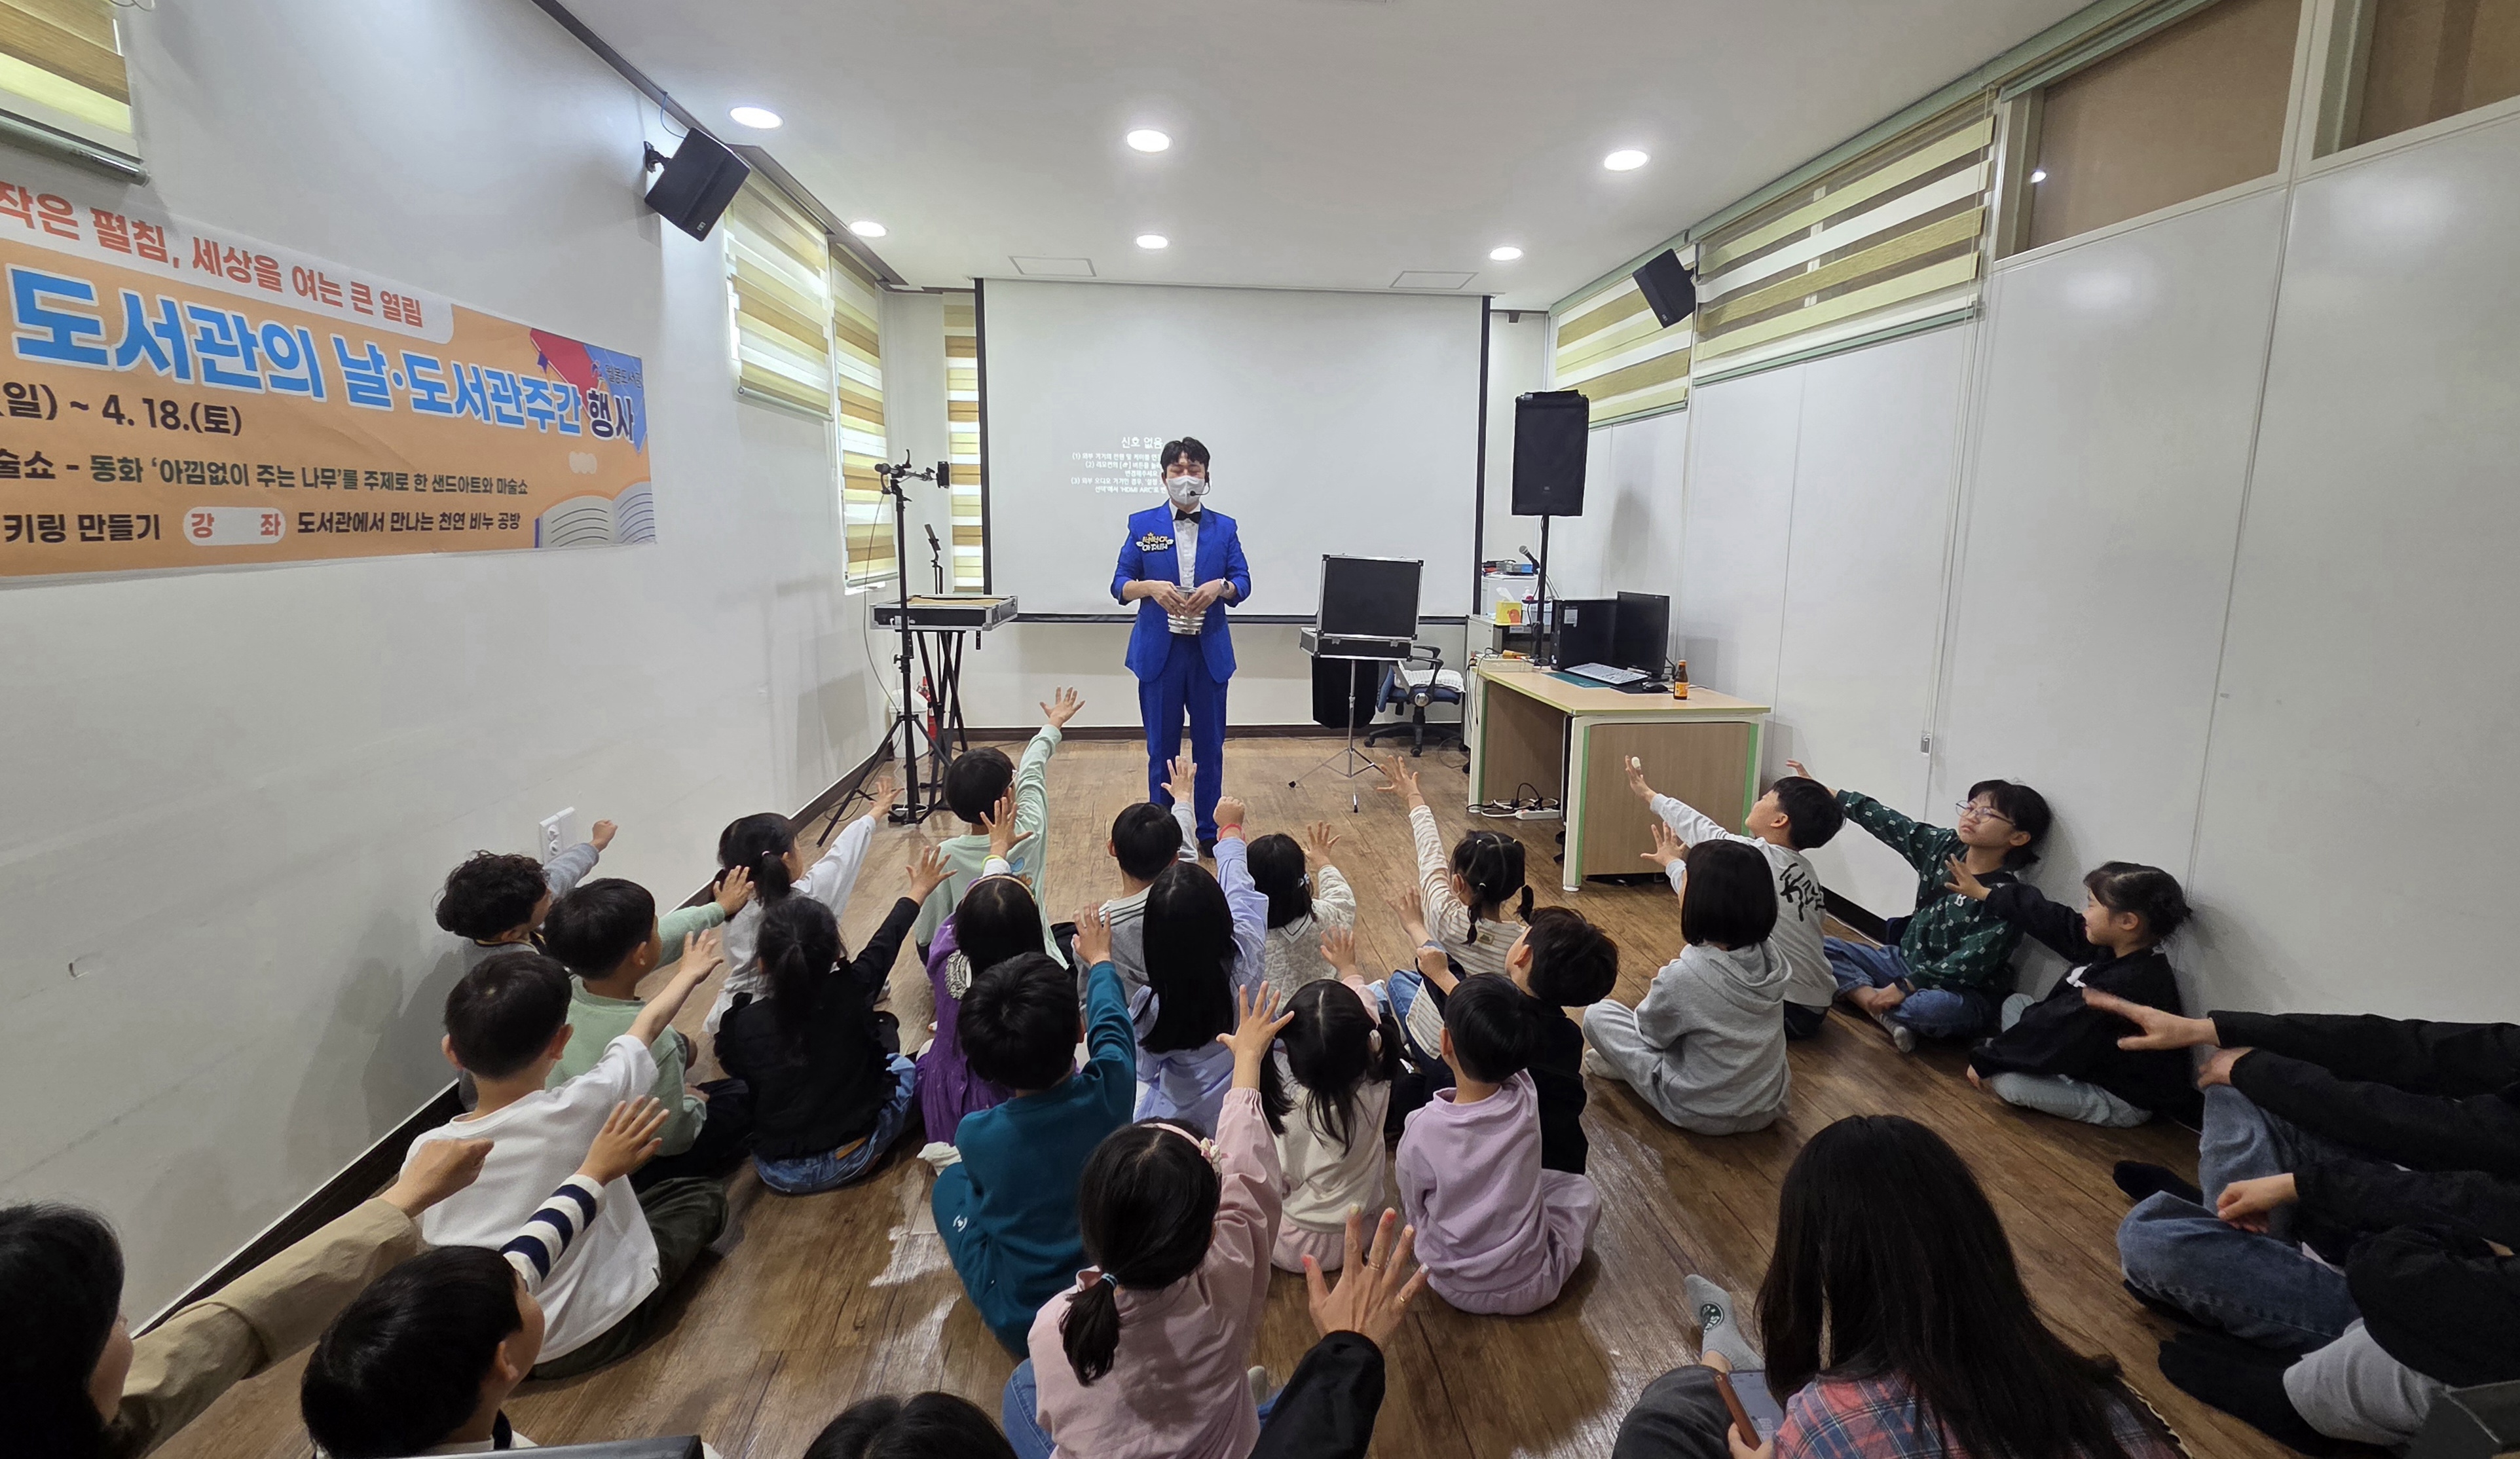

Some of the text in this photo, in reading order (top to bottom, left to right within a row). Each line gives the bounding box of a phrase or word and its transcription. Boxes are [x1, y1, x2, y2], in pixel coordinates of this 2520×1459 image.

[0, 181, 422, 328] 작은 펼침, 세상을 여는 큰 열림
[12, 270, 325, 399] 도서관의
[587, 389, 634, 441] 행사
[0, 381, 58, 421] 일)
[1121, 437, 1163, 449] 신호 없음
[89, 454, 144, 484] 동화
[256, 464, 296, 489] 주는
[363, 470, 410, 492] 주제로
[413, 472, 429, 493] 한
[431, 474, 494, 494] 샌드아트와
[496, 477, 528, 496] 마술쇼
[2, 513, 67, 544] 키링
[77, 513, 161, 543] 만들기
[297, 511, 386, 534] 도서관에서
[390, 511, 435, 533] 만나는
[438, 511, 466, 532] 천연
[468, 511, 494, 531] 비누
[497, 511, 521, 530] 공방
